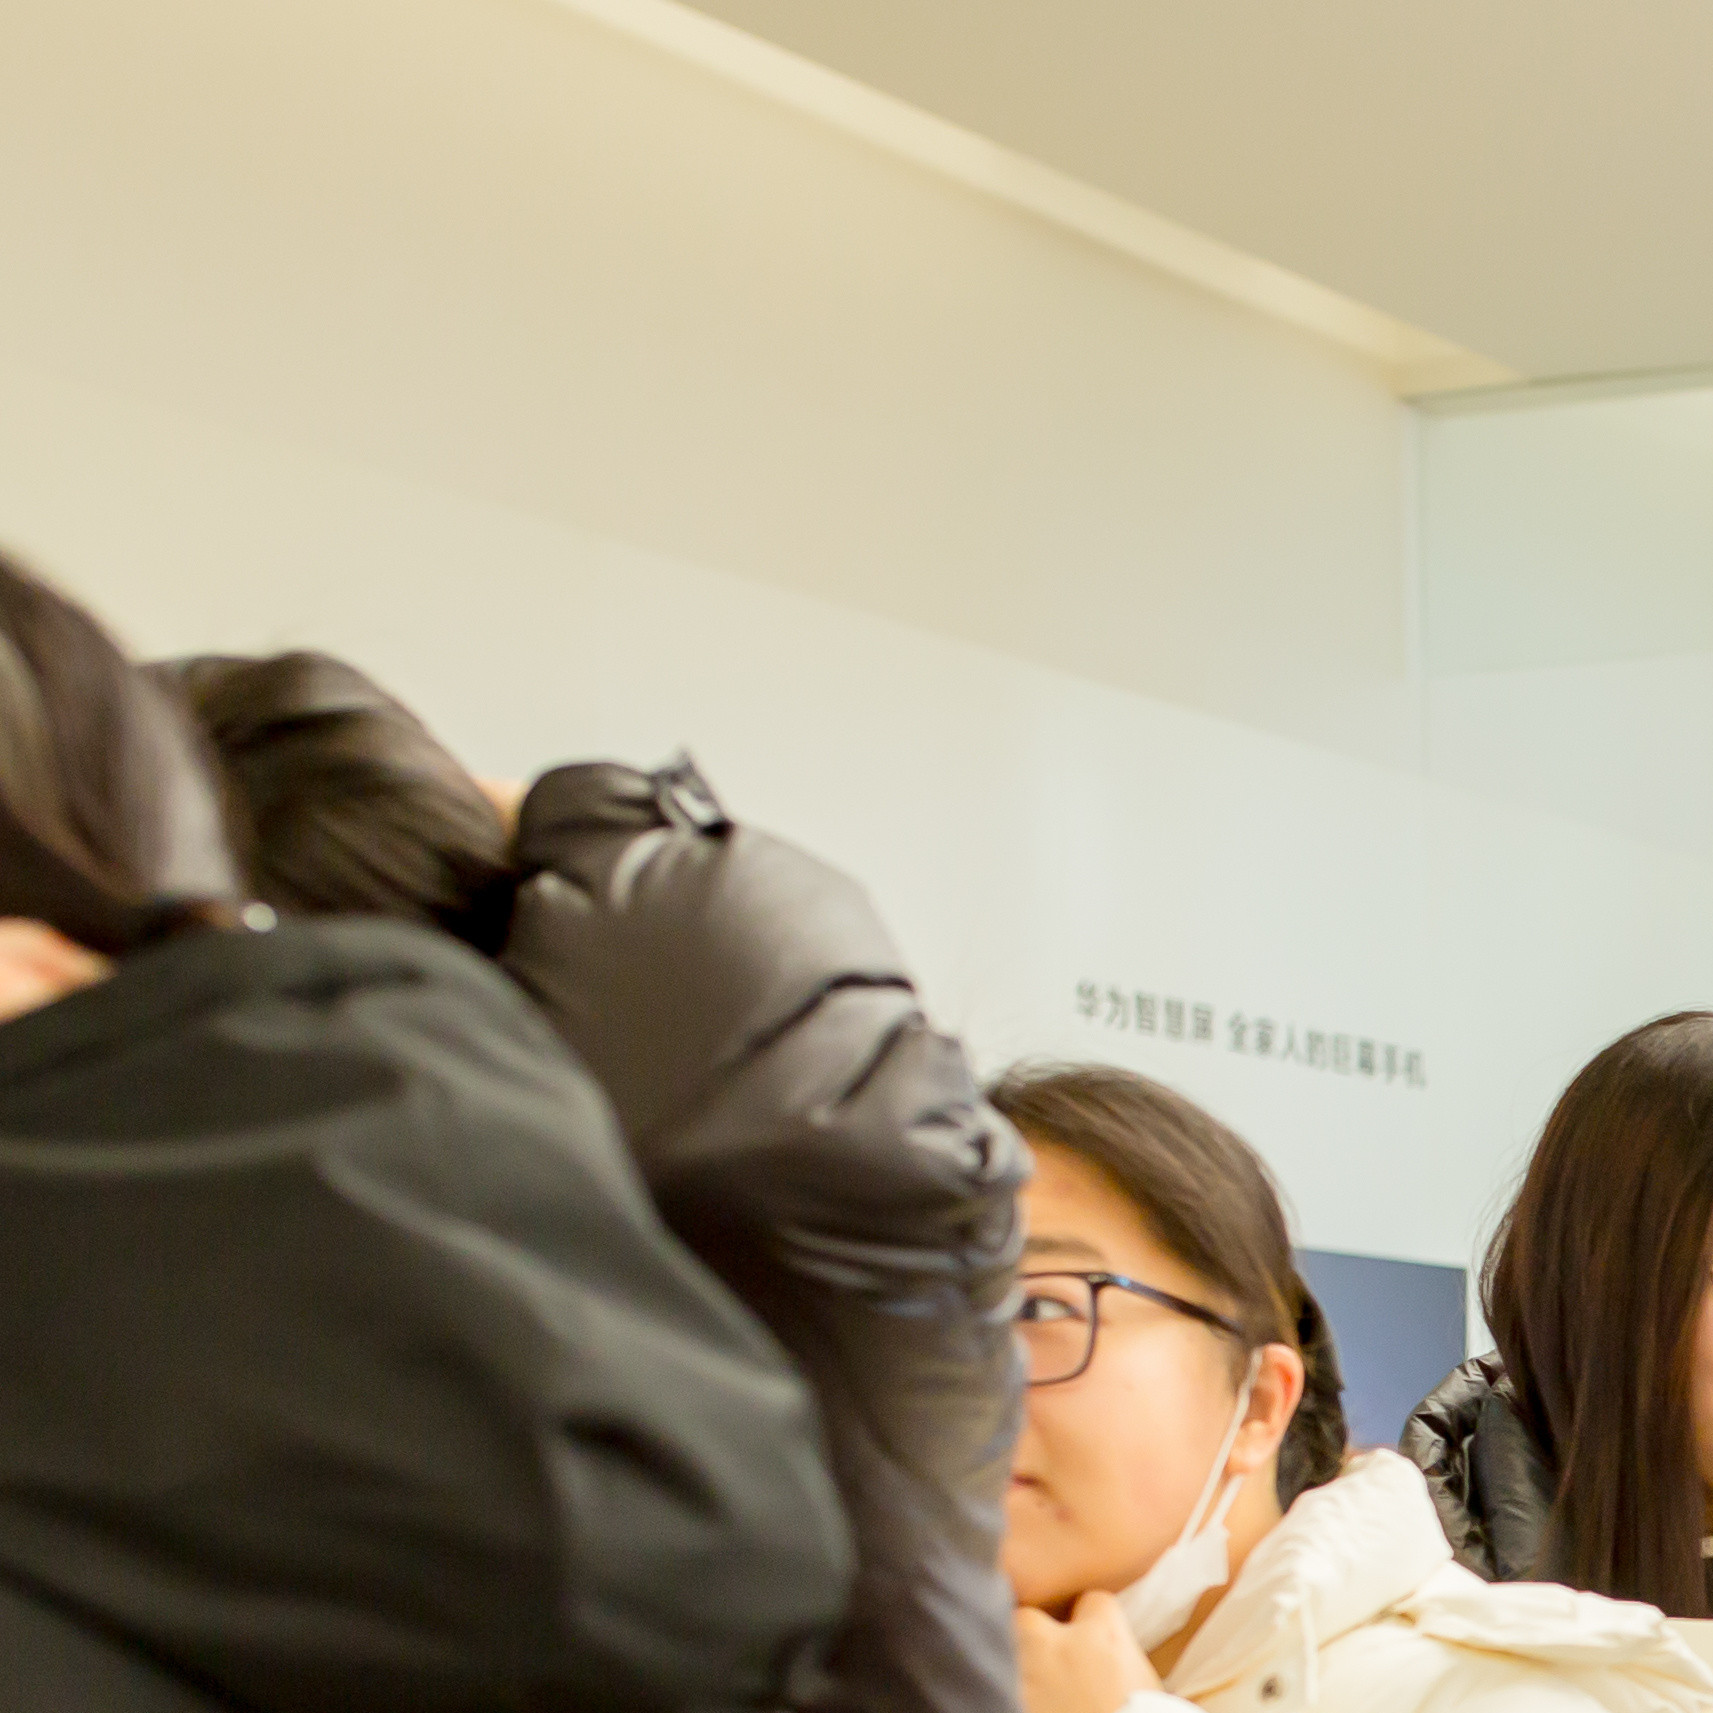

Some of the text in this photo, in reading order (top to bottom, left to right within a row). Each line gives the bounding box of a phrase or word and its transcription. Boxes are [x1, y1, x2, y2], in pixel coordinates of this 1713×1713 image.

[1076, 979, 1214, 1042] 华为智慧屏
